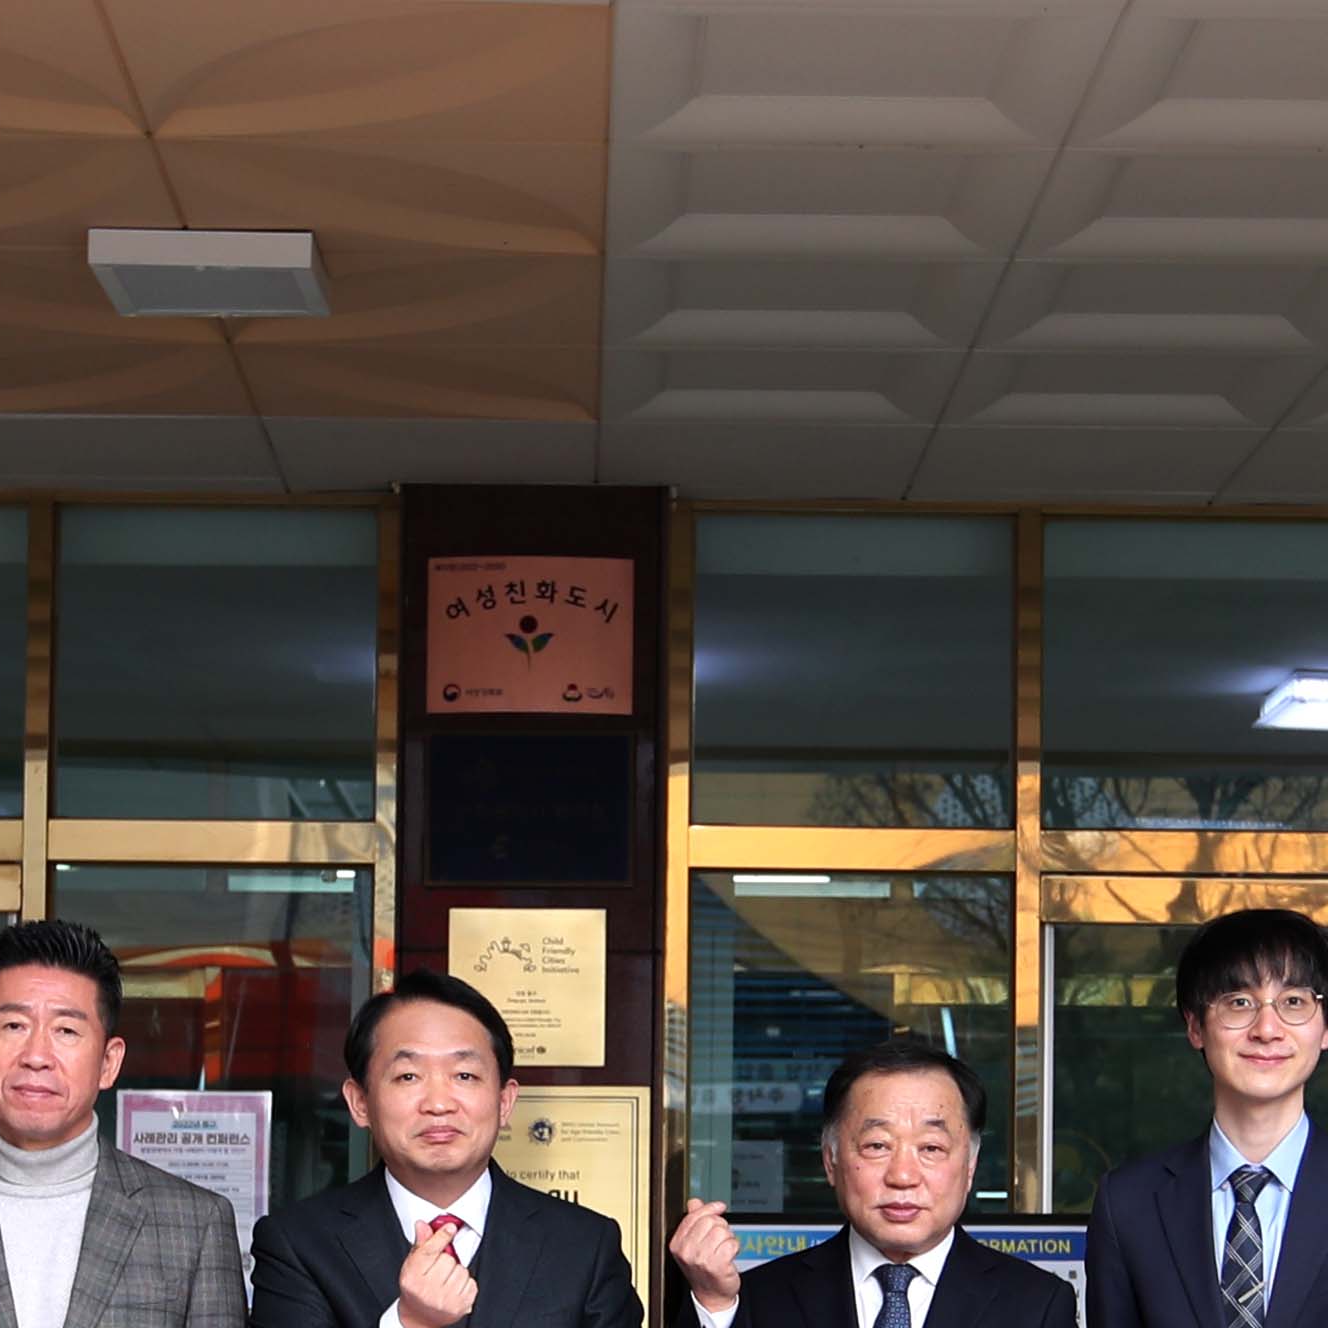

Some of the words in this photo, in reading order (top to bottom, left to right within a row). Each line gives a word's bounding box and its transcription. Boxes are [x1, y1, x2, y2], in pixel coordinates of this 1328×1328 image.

[446, 580, 619, 623] 여성친화도시
[542, 936, 564, 946] Child
[542, 946, 576, 956] Friendly
[542, 956, 565, 965] Cities
[520, 1169, 555, 1180] certify
[559, 1170, 580, 1180] that
[744, 1236, 807, 1254] 사안내
[977, 1239, 1071, 1254] RMATION
